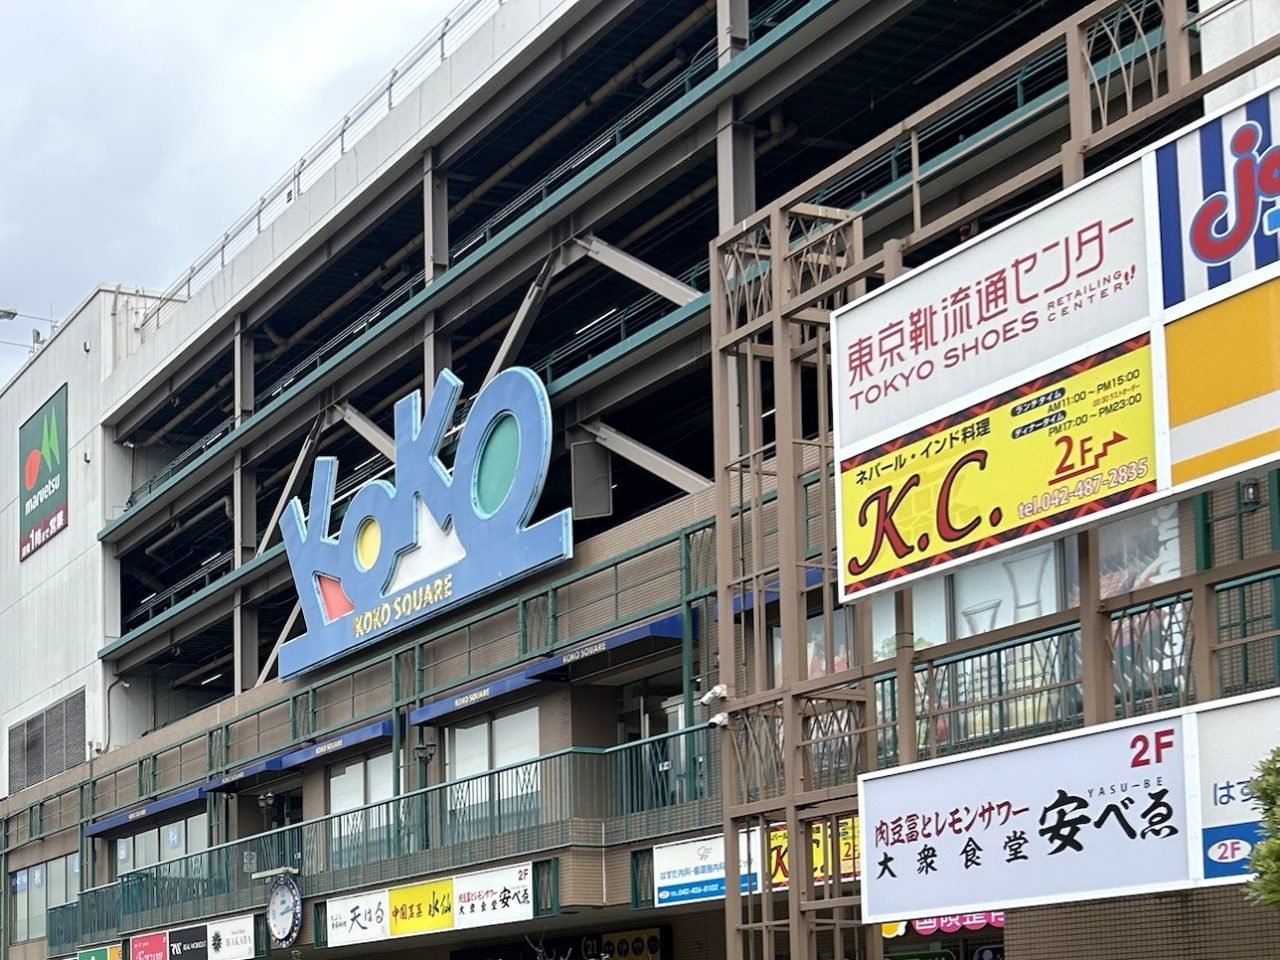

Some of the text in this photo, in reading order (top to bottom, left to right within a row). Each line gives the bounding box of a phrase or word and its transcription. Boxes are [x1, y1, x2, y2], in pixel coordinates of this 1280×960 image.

[848, 218, 1134, 386] 東京靴流通センター
[1047, 270, 1122, 310] RETAILING
[1047, 282, 1123, 322] CENTER
[850, 310, 1039, 411] TOKYO SHOES
[1055, 434, 1094, 477] 2F
[848, 449, 1004, 575] K.C.
[353, 573, 452, 638] KOKO SQUARE
[562, 640, 607, 664] KOKO SQUARE
[1130, 728, 1175, 769] 2F
[1038, 788, 1179, 857] 安べゑ
[1217, 840, 1241, 861] 2F
[518, 868, 529, 881] 2F
